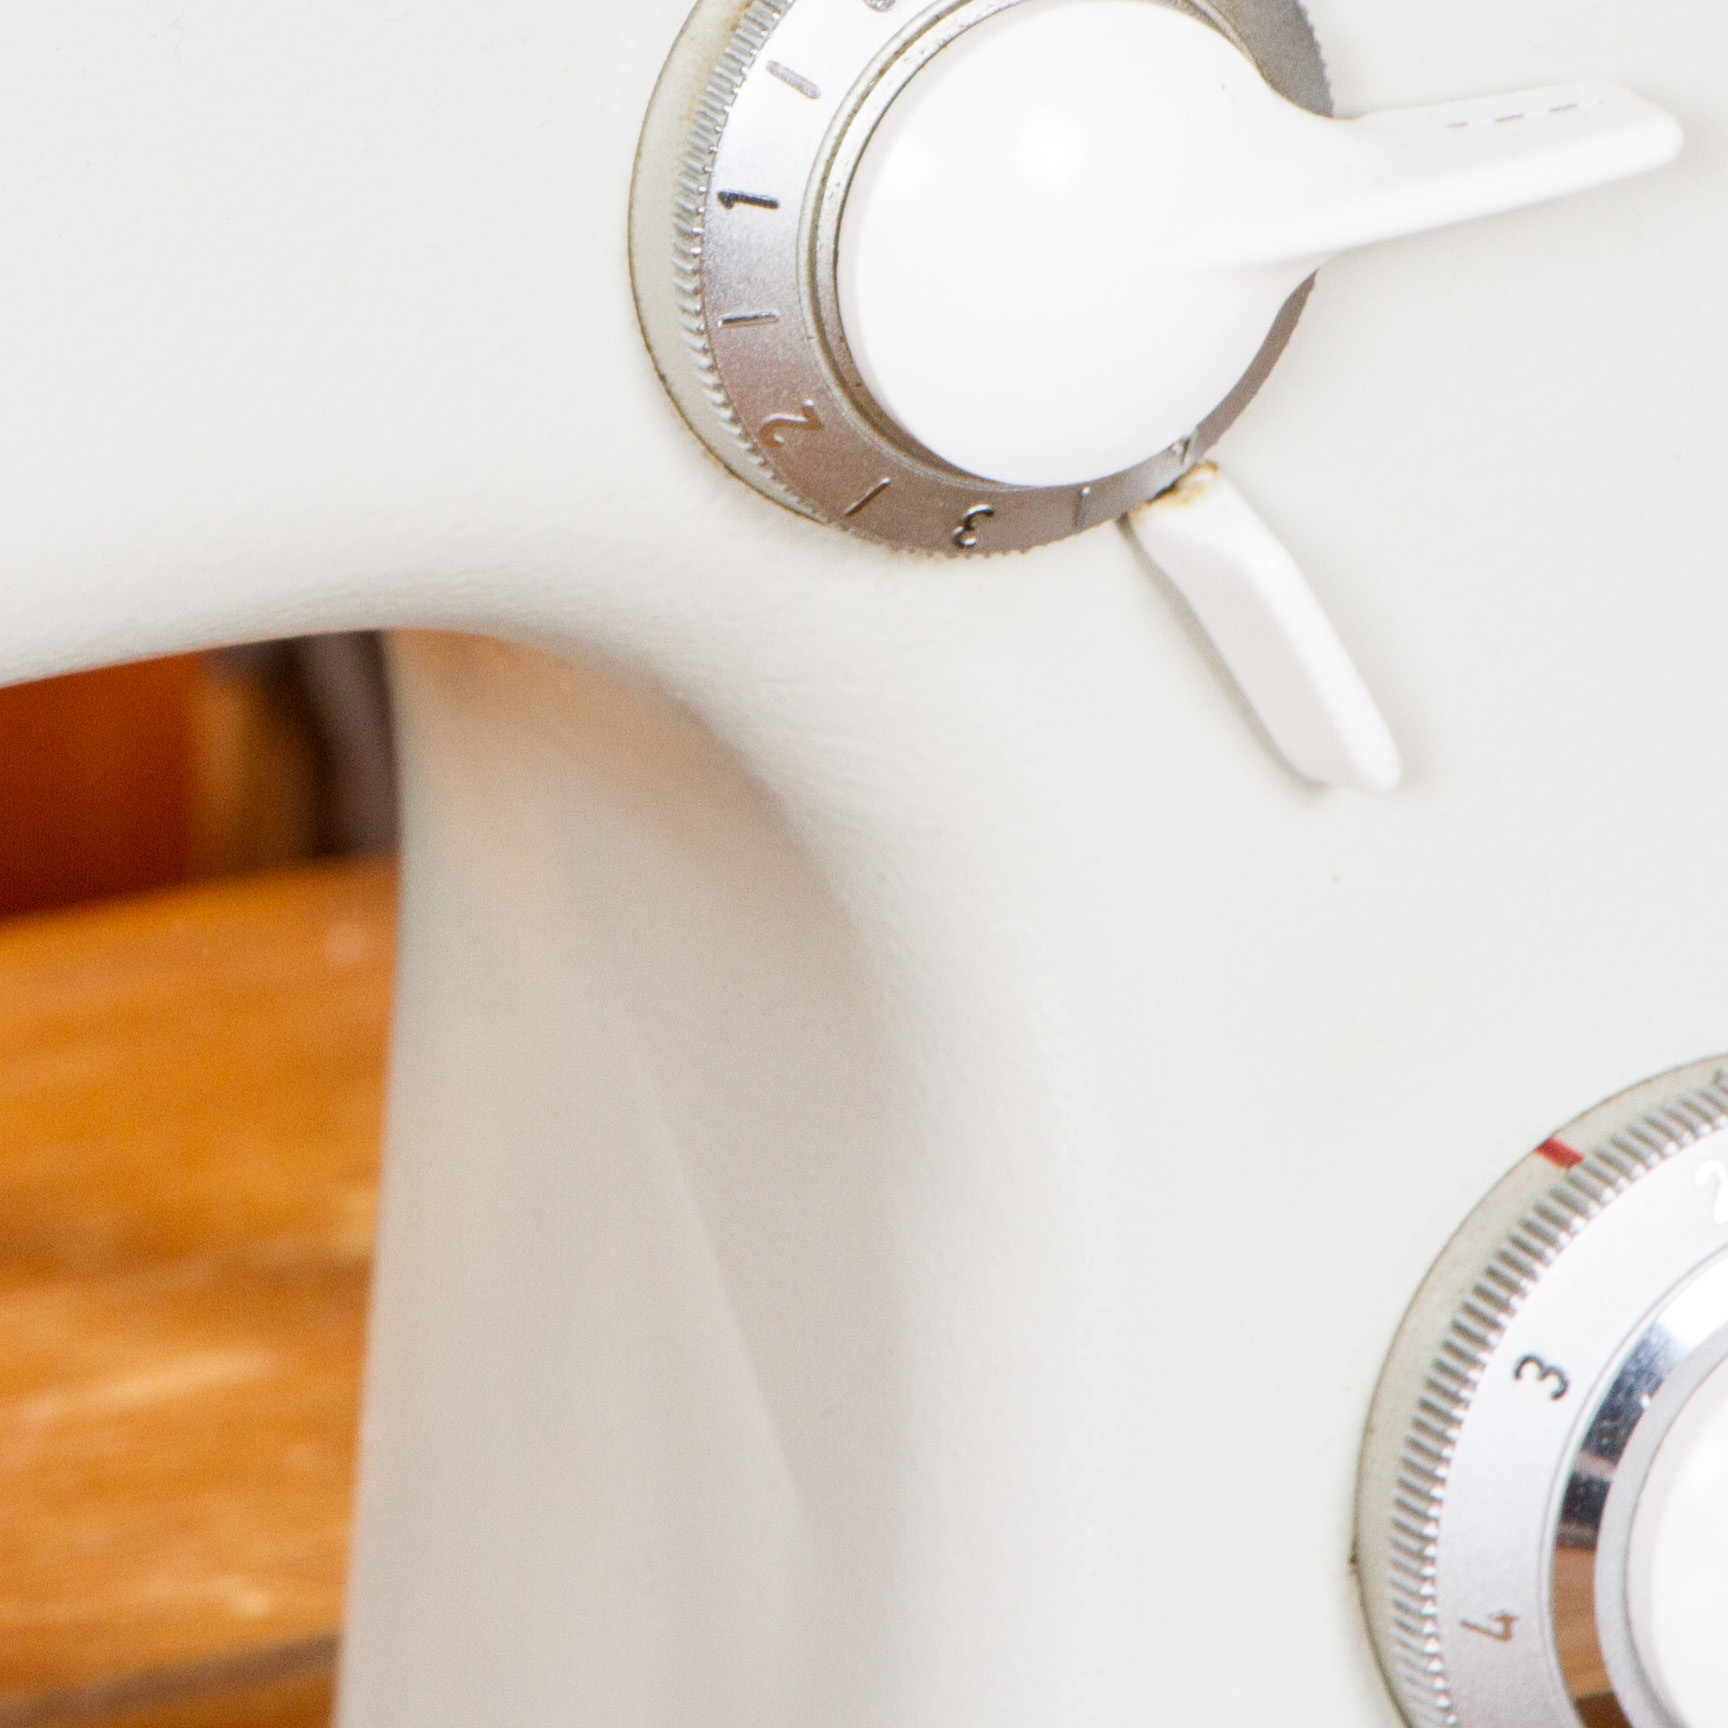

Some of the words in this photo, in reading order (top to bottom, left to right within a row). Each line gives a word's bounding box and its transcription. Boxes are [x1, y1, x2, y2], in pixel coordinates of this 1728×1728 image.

[717, 189, 780, 211] 1
[758, 398, 823, 449] 2
[1512, 1353, 1571, 1402] 3
[1459, 1605, 1520, 1644] 4
